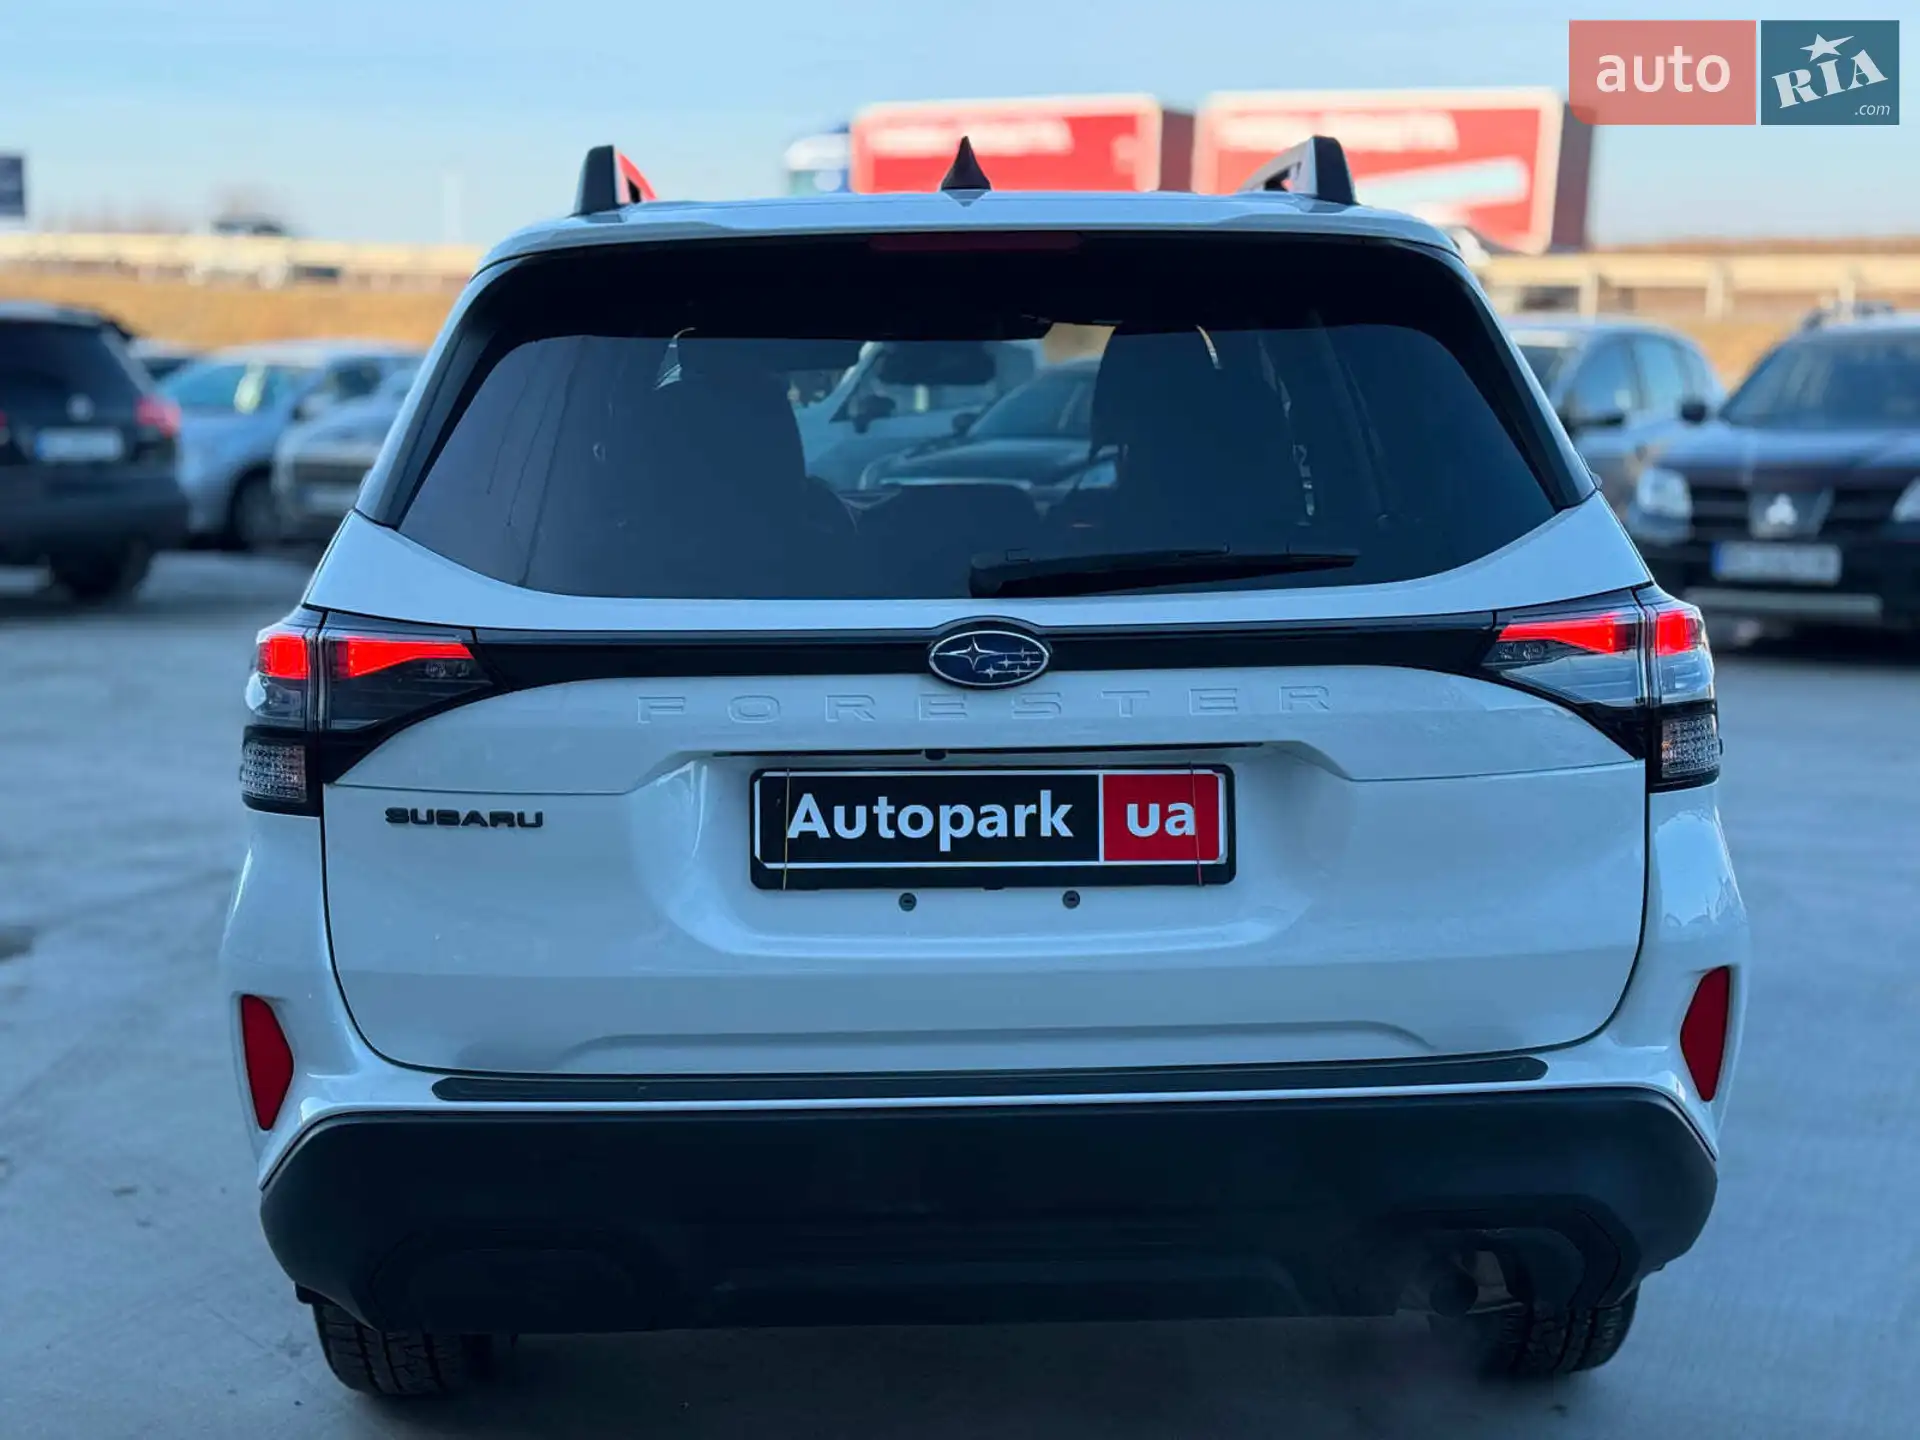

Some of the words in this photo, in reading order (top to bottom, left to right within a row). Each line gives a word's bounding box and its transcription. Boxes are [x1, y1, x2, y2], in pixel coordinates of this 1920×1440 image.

[636, 684, 1331, 724] FORESTER
[384, 806, 543, 829] SUBARU
[786, 789, 1074, 852] Autopark
[1126, 802, 1196, 837] ua
